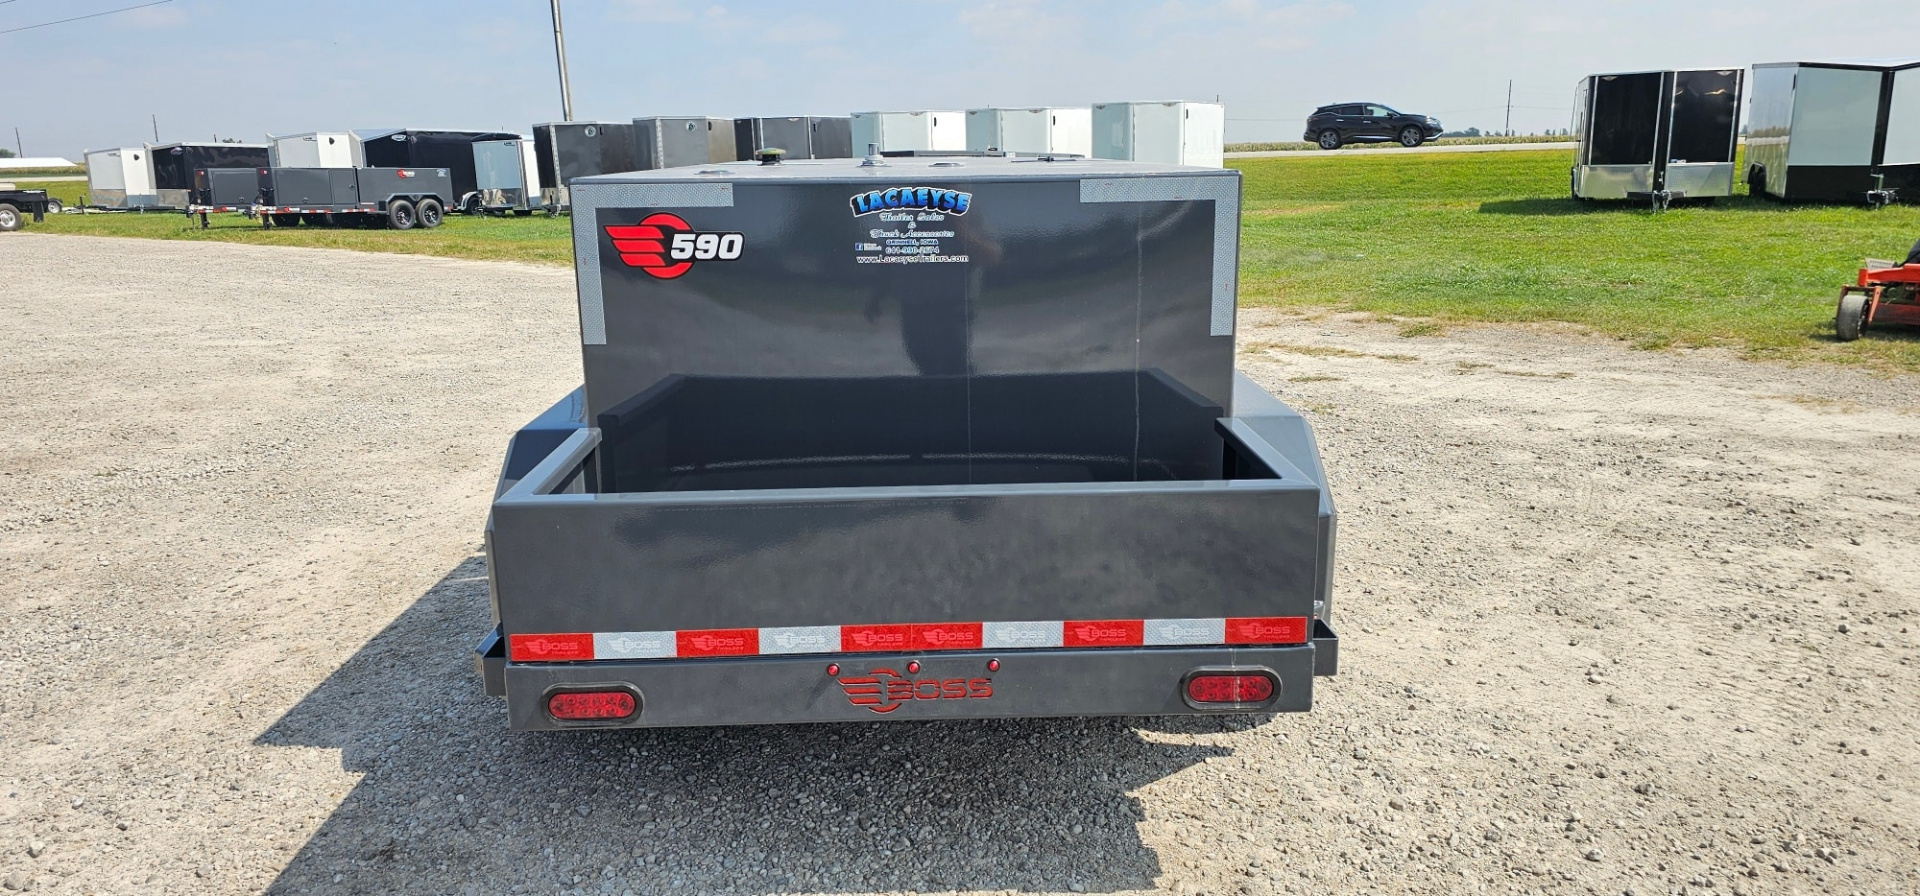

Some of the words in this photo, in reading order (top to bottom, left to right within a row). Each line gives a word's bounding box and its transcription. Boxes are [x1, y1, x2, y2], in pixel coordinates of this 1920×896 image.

[853, 188, 971, 214] LACAEYSE
[669, 232, 743, 260] 590
[1091, 629, 1126, 637] BOSS
[1255, 626, 1290, 634] BOSS
[868, 634, 903, 642] BOSS
[939, 632, 974, 640] BOSS
[542, 642, 578, 650] BOSS
[708, 638, 743, 646] BOSS
[887, 678, 994, 700] BOSS
